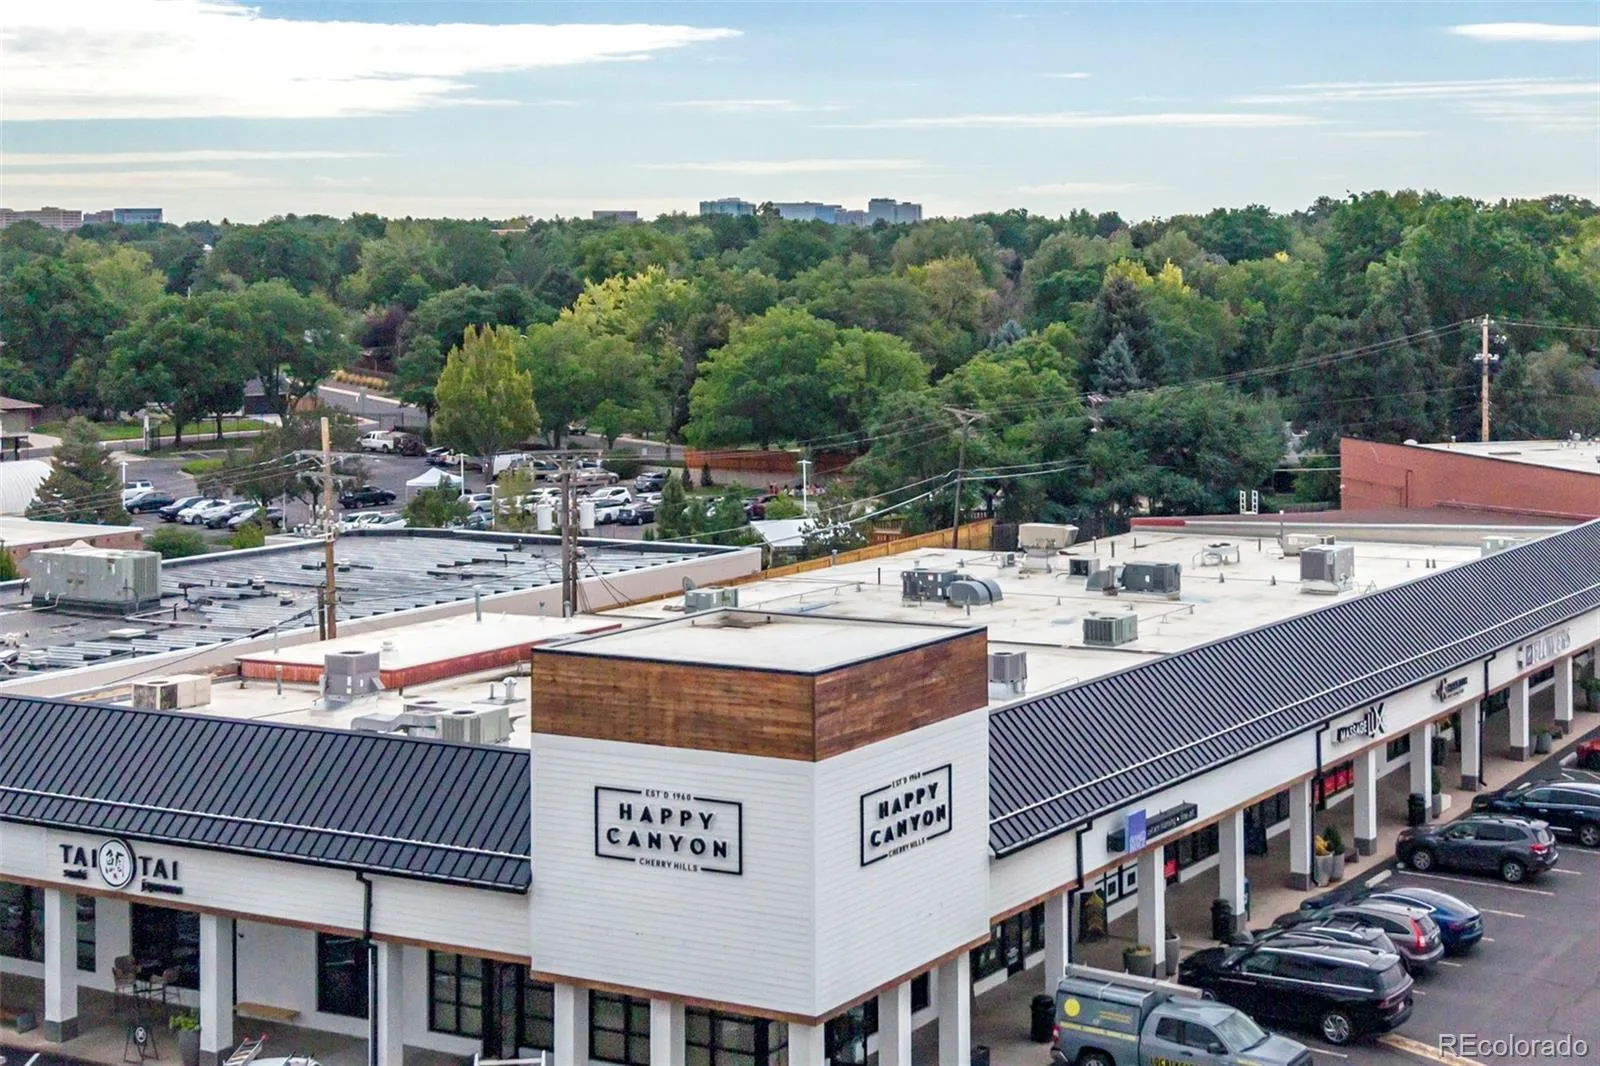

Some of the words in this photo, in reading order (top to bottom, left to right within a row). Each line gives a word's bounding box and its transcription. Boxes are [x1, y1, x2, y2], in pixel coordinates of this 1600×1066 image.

[673, 792, 691, 801] 1960
[879, 782, 938, 819] HAPPY
[619, 803, 714, 830] HAPPY
[870, 804, 946, 847] CANYON
[606, 827, 727, 858] CANYON
[888, 843, 909, 857] CHERRY
[910, 837, 926, 848] HILLS
[59, 844, 97, 868] TAI
[138, 856, 178, 881] TAI
[639, 857, 671, 869] CHERRY
[673, 863, 698, 873] HILLS
